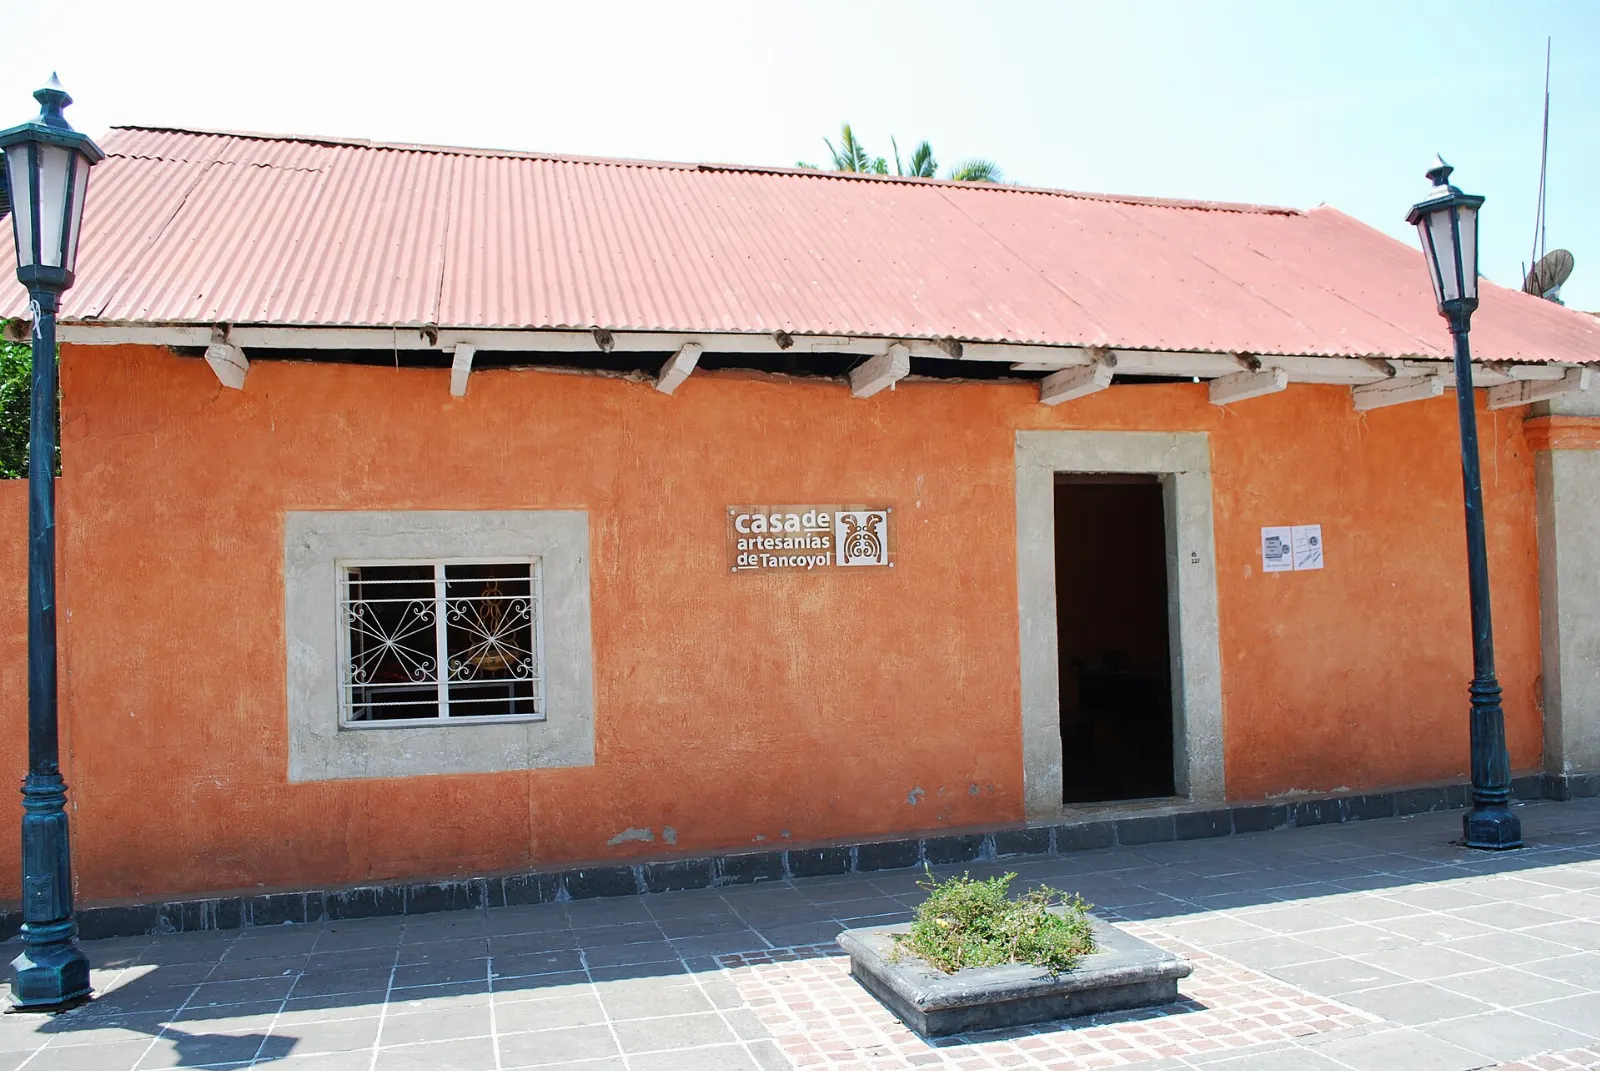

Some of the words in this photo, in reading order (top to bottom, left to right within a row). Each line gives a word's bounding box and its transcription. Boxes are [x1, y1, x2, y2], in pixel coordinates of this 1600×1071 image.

[737, 533, 830, 550] artesanías
[737, 552, 758, 566] de
[759, 551, 831, 570] Tancoyol
